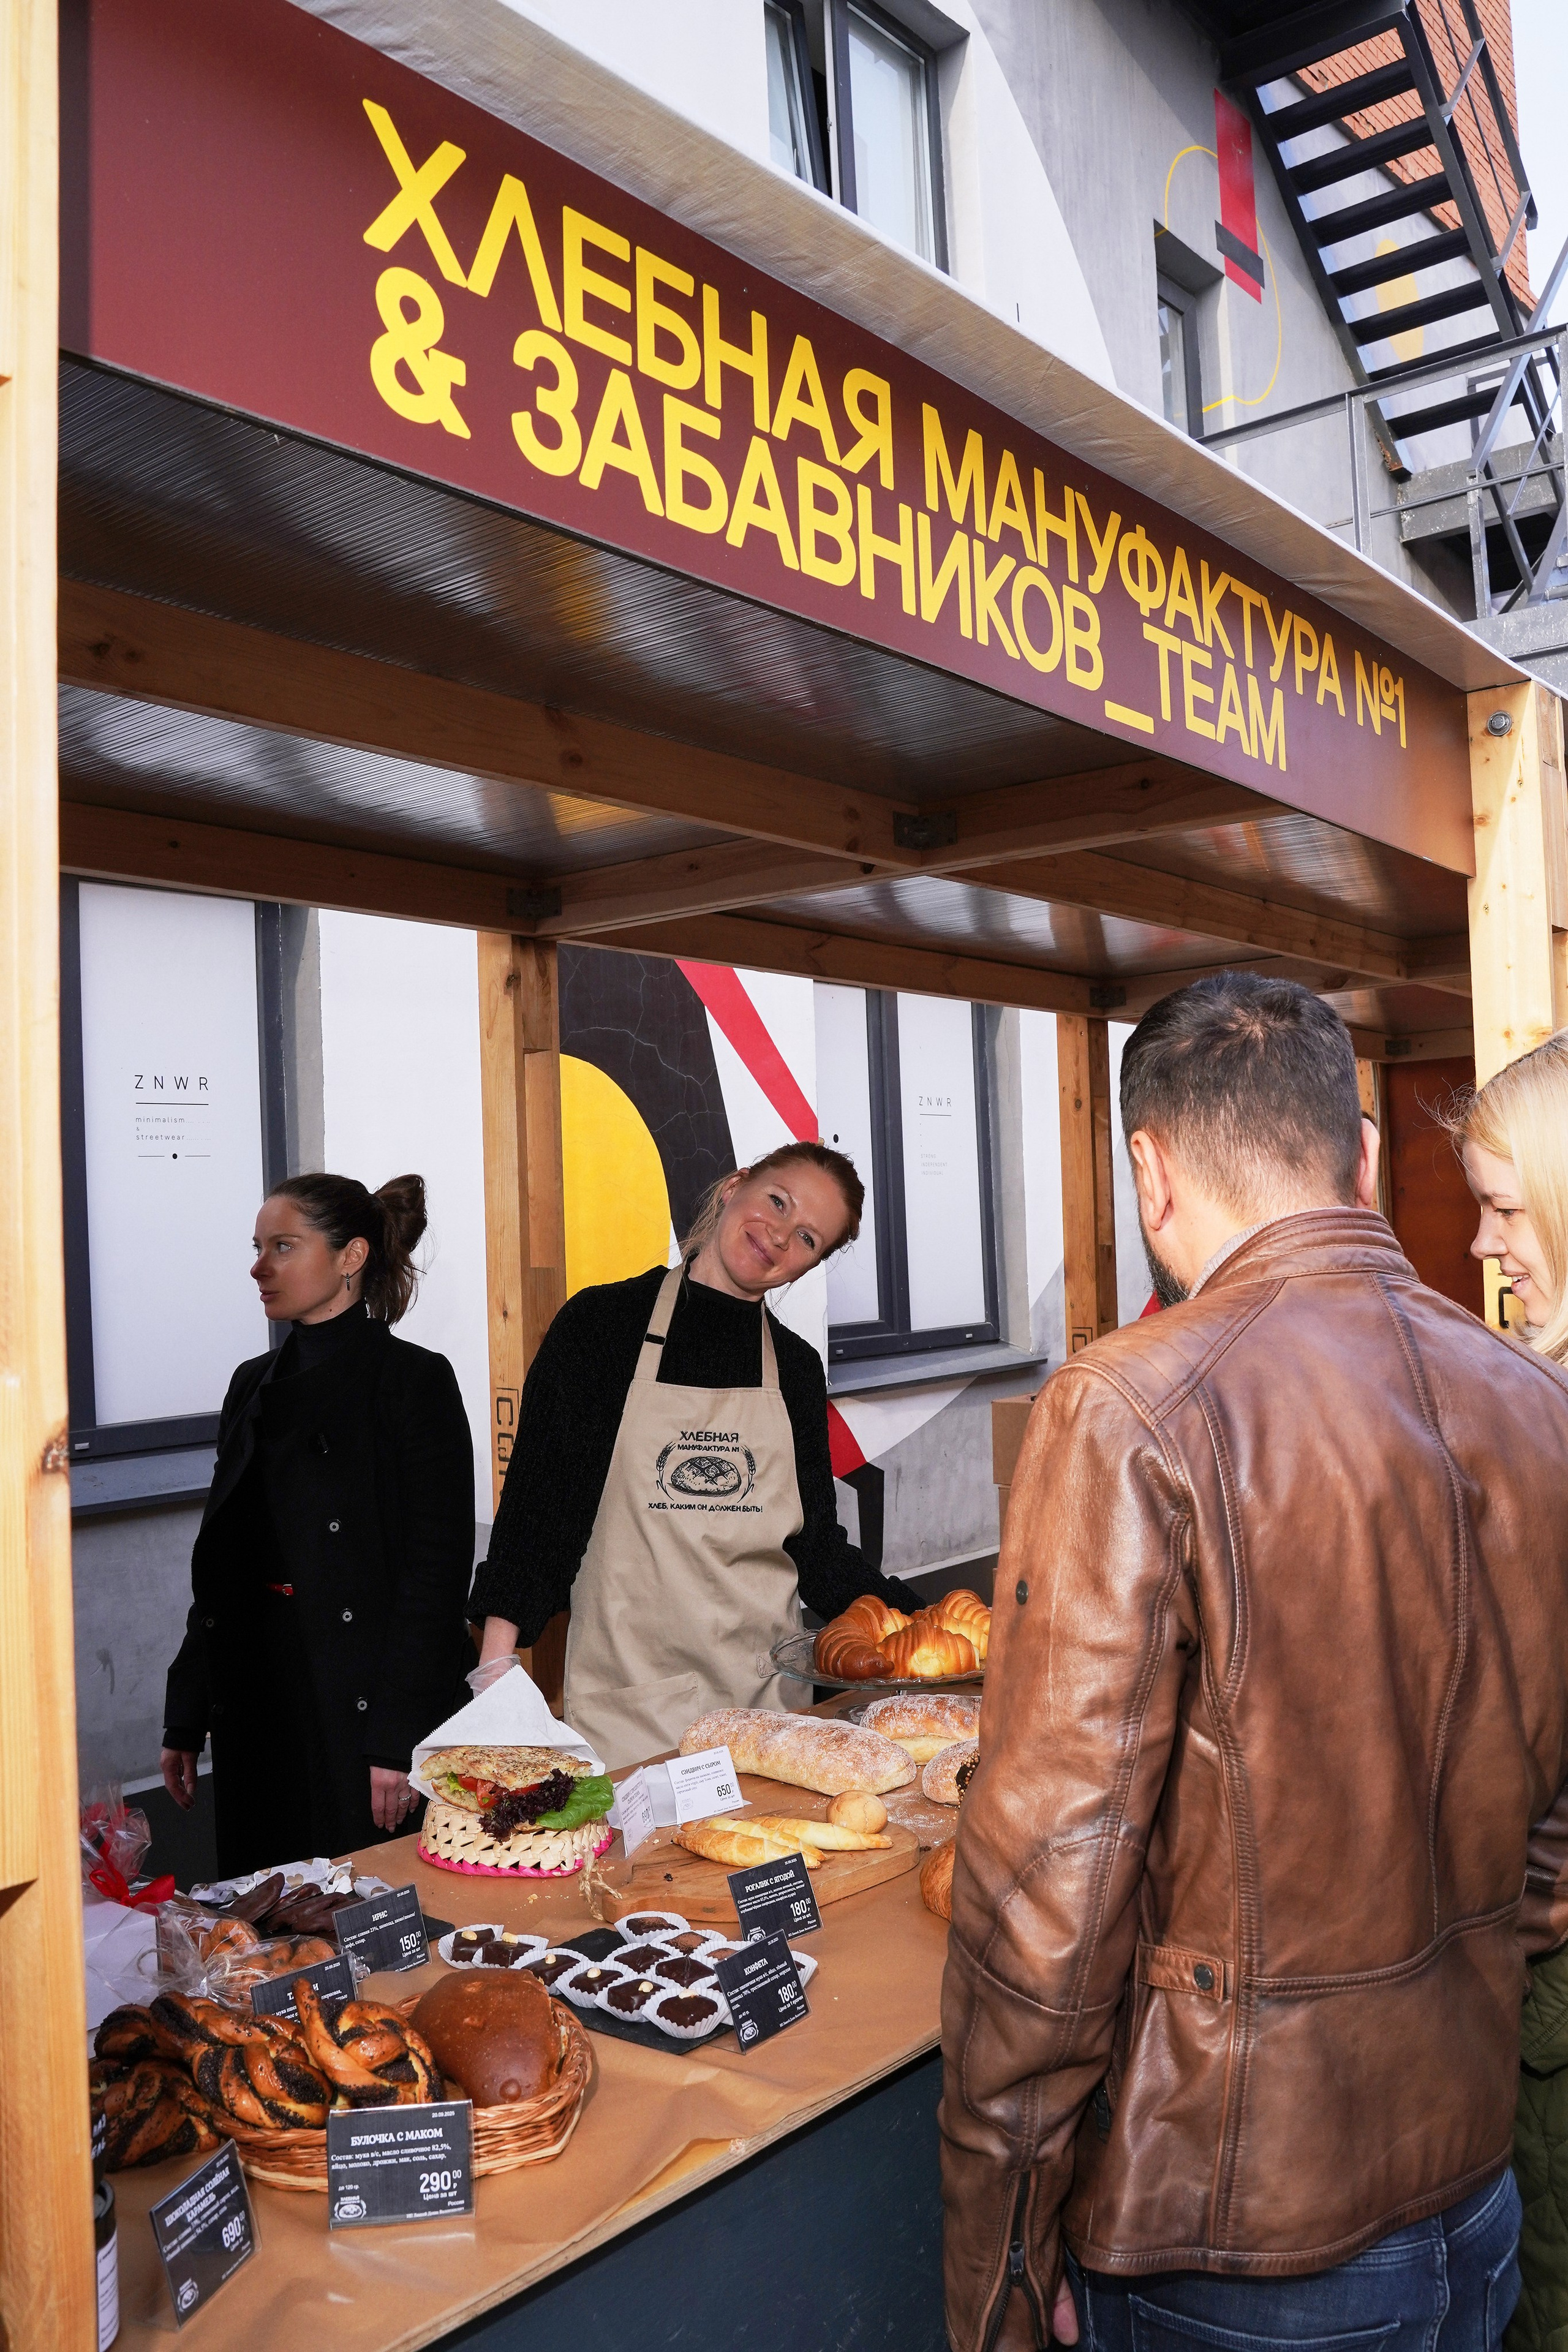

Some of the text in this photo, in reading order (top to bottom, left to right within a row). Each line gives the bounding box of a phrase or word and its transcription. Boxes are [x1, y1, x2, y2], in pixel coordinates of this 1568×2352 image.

[369, 266, 472, 440] &
[362, 98, 894, 491] ХЛЕБНАЯ
[922, 402, 1346, 717] МАНУФАКТУРА
[134, 1074, 208, 1091] ZNWR
[918, 1096, 952, 1107] ZNWR
[679, 1430, 739, 1443] ХЛЕБНАЯ
[677, 1444, 731, 1453] МАНУФАКТУРА
[680, 1765, 701, 1775] СЭНДВИЧ
[717, 1784, 731, 1796] 650
[745, 1879, 769, 1893] РОГАЛИК
[774, 1869, 794, 1883] ЯГОДОЙ
[371, 1910, 388, 1921] ИРИС
[790, 1899, 807, 1917] 180
[399, 1933, 417, 1951] 150
[744, 1958, 768, 1975] КОНФЕТА
[778, 1983, 794, 2003] 180
[350, 2127, 443, 2146] БУЛОЧКА С МАКОМ
[419, 2171, 451, 2193] 290
[452, 2169, 461, 2179] 00
[186, 2192, 216, 2222] КАРАМЕЛЬ
[222, 2216, 241, 2247] 690
